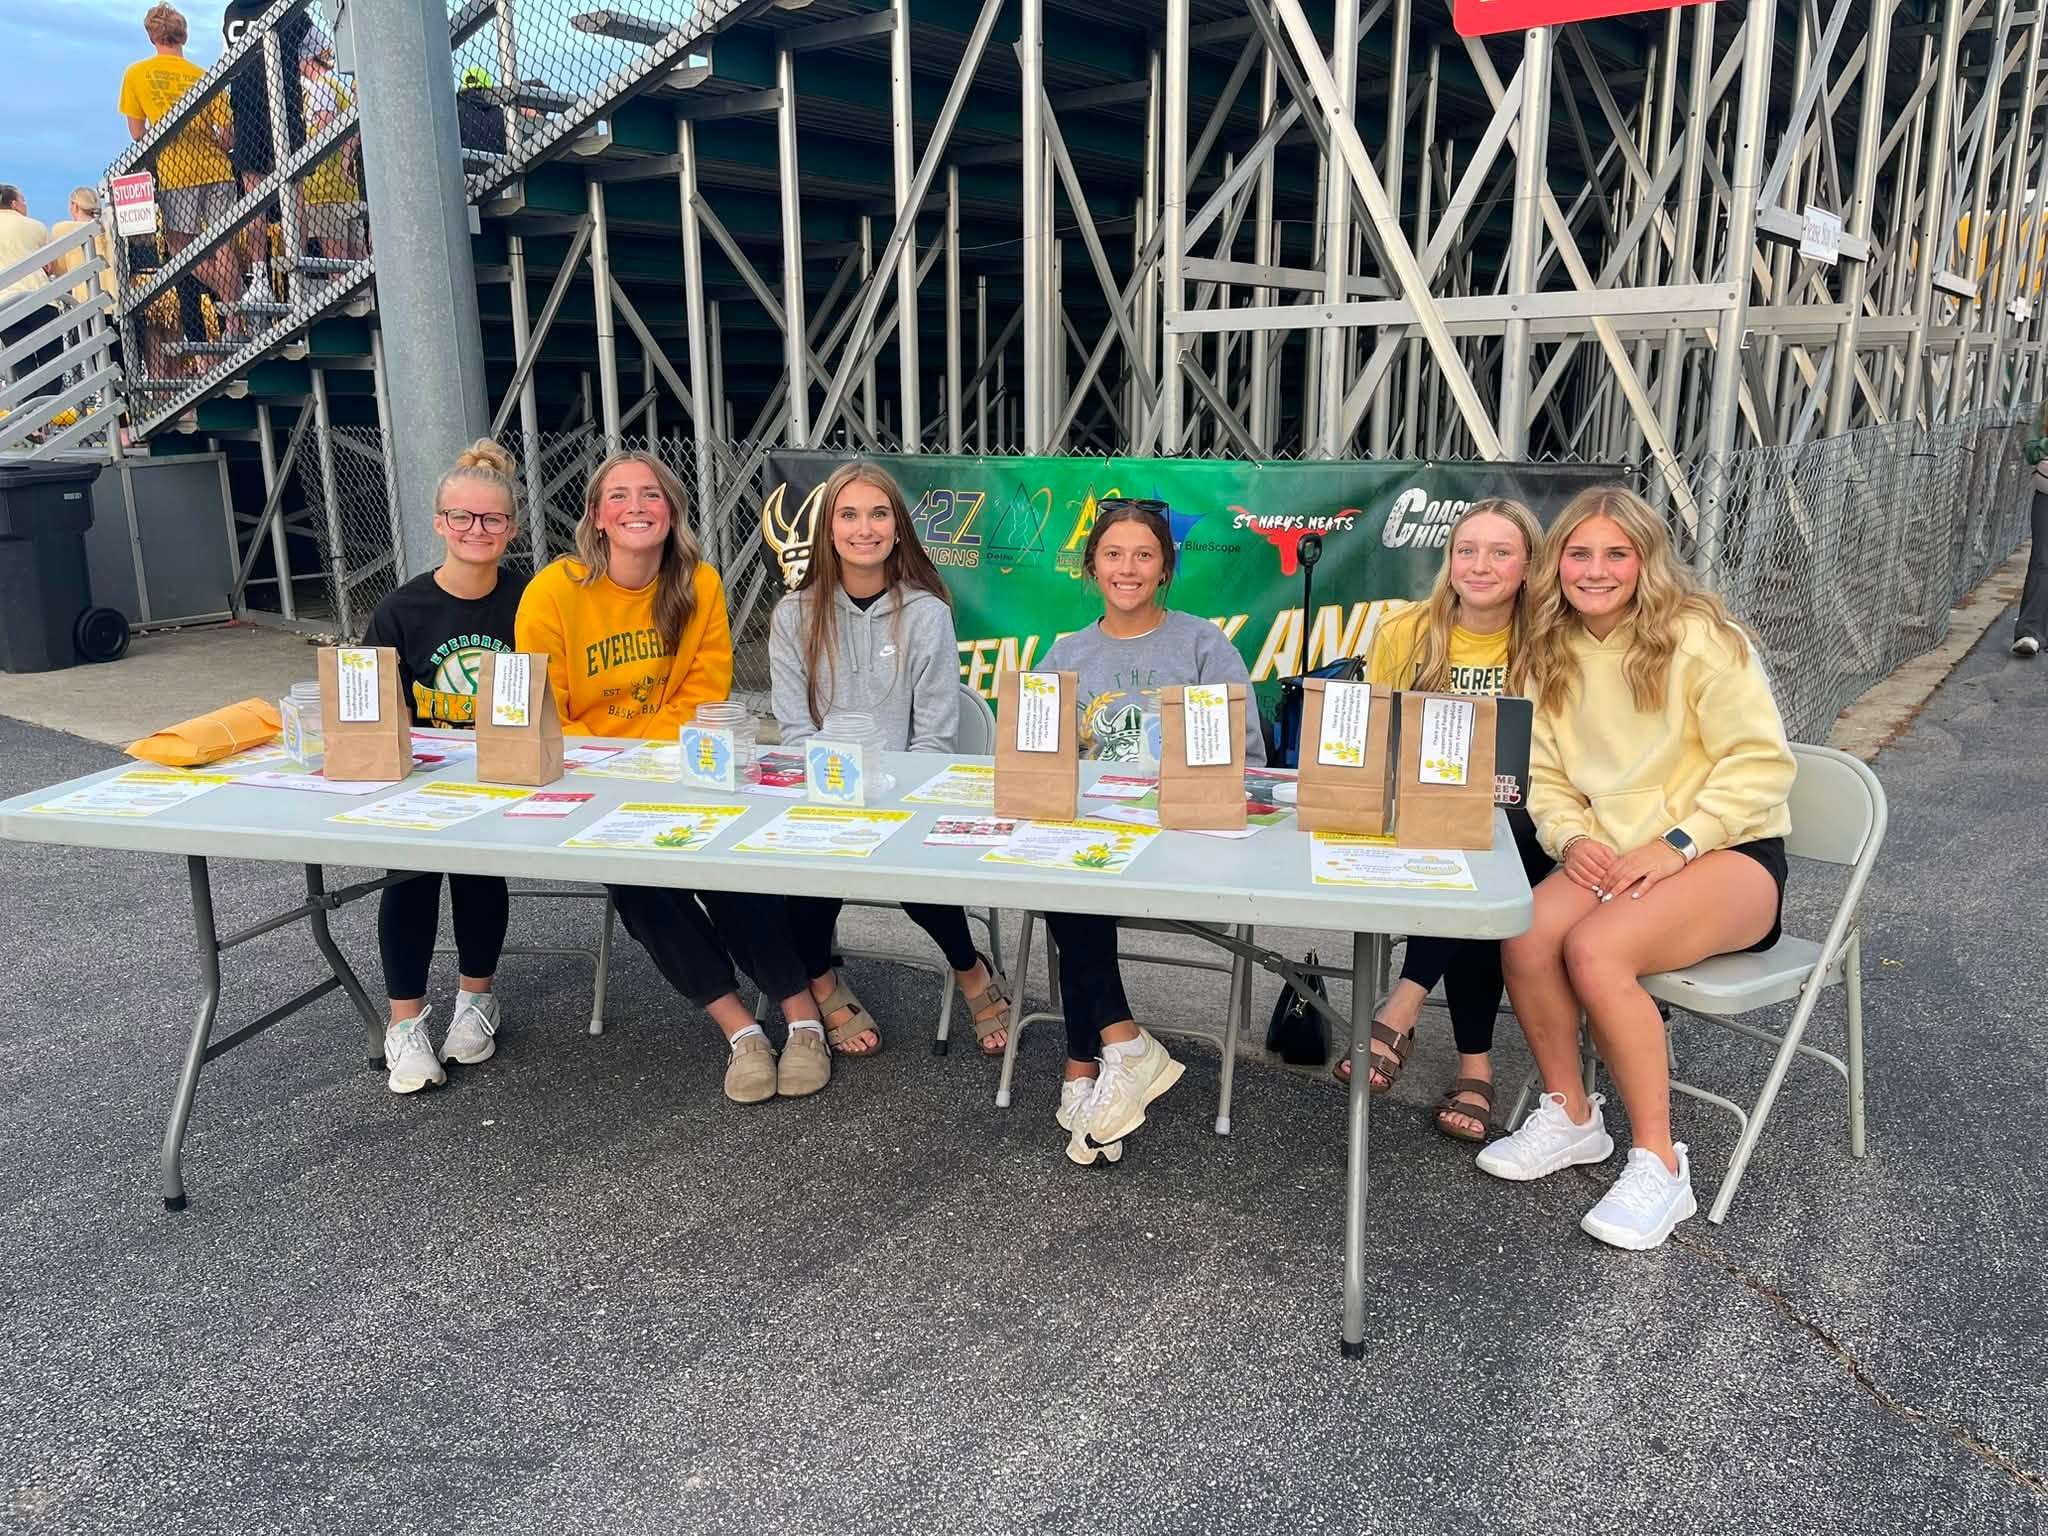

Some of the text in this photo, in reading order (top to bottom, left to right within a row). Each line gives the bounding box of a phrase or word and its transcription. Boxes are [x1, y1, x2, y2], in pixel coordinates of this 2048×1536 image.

[114, 182, 151, 201] STUDENT
[119, 207, 151, 224] SECTION
[1232, 514, 1355, 532] ST MARY'S MEATS
[1185, 540, 1241, 555] BlueScope
[430, 633, 512, 666] EVERGREE
[586, 628, 665, 678] EVERGR
[1113, 670, 1157, 688] THE
